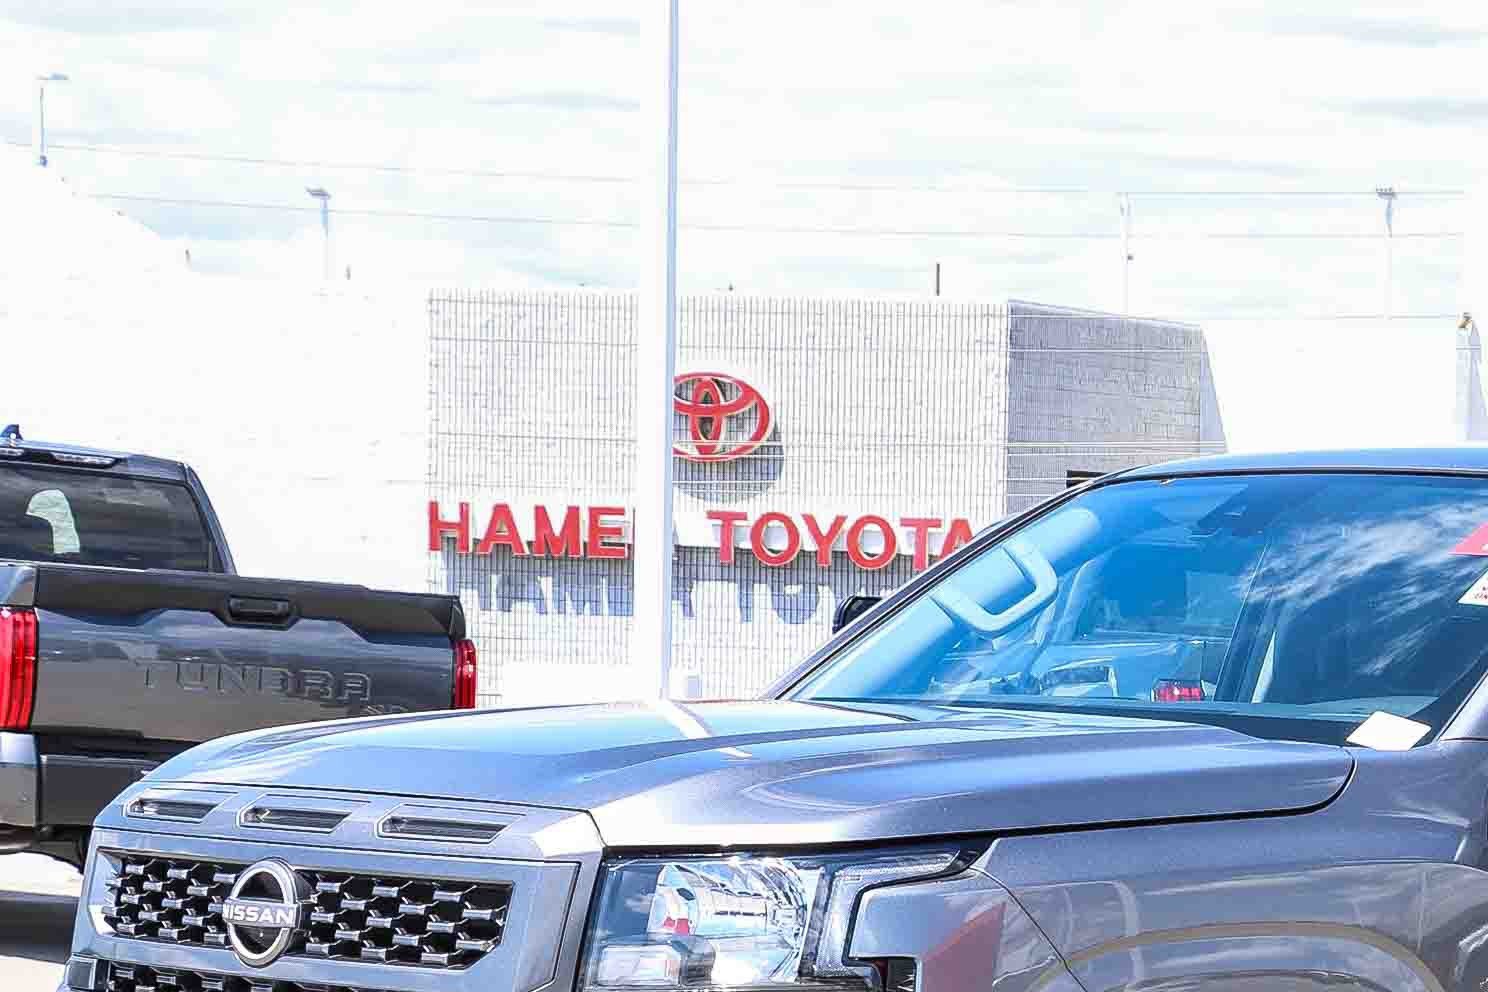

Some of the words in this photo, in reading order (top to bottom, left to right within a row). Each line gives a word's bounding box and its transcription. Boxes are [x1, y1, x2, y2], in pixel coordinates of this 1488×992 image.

[428, 501, 635, 559] HAME
[707, 510, 976, 571] TOYOTA
[134, 655, 373, 701] TUNDRA
[222, 902, 295, 925] NISSAN
